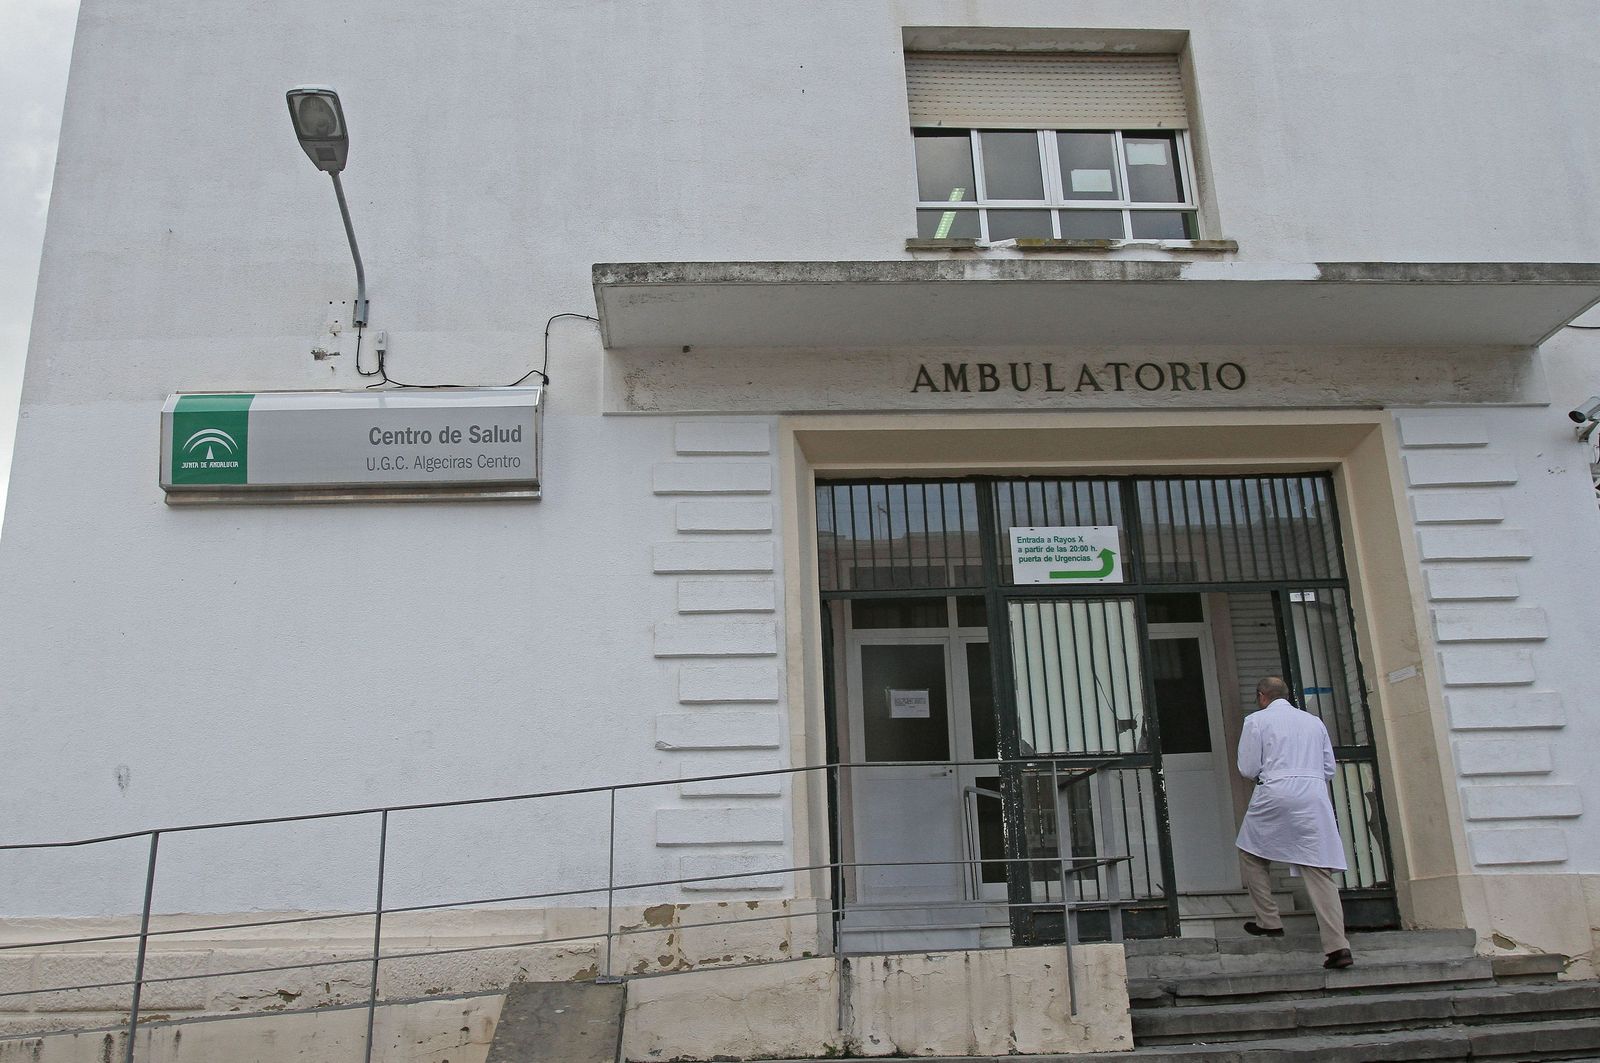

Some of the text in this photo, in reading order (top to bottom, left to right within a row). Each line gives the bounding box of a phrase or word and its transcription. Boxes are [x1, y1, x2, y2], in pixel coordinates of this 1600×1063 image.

[911, 362, 1246, 393] AMBULATORIO
[369, 425, 522, 445] Centro de Salud
[181, 461, 199, 469] JUNTA
[200, 461, 208, 469] DE
[366, 454, 521, 473] U.G.C. Algeciras Centro
[1054, 536, 1076, 544] Rayos
[1024, 546, 1043, 554] partir
[1018, 556, 1042, 564] puerta
